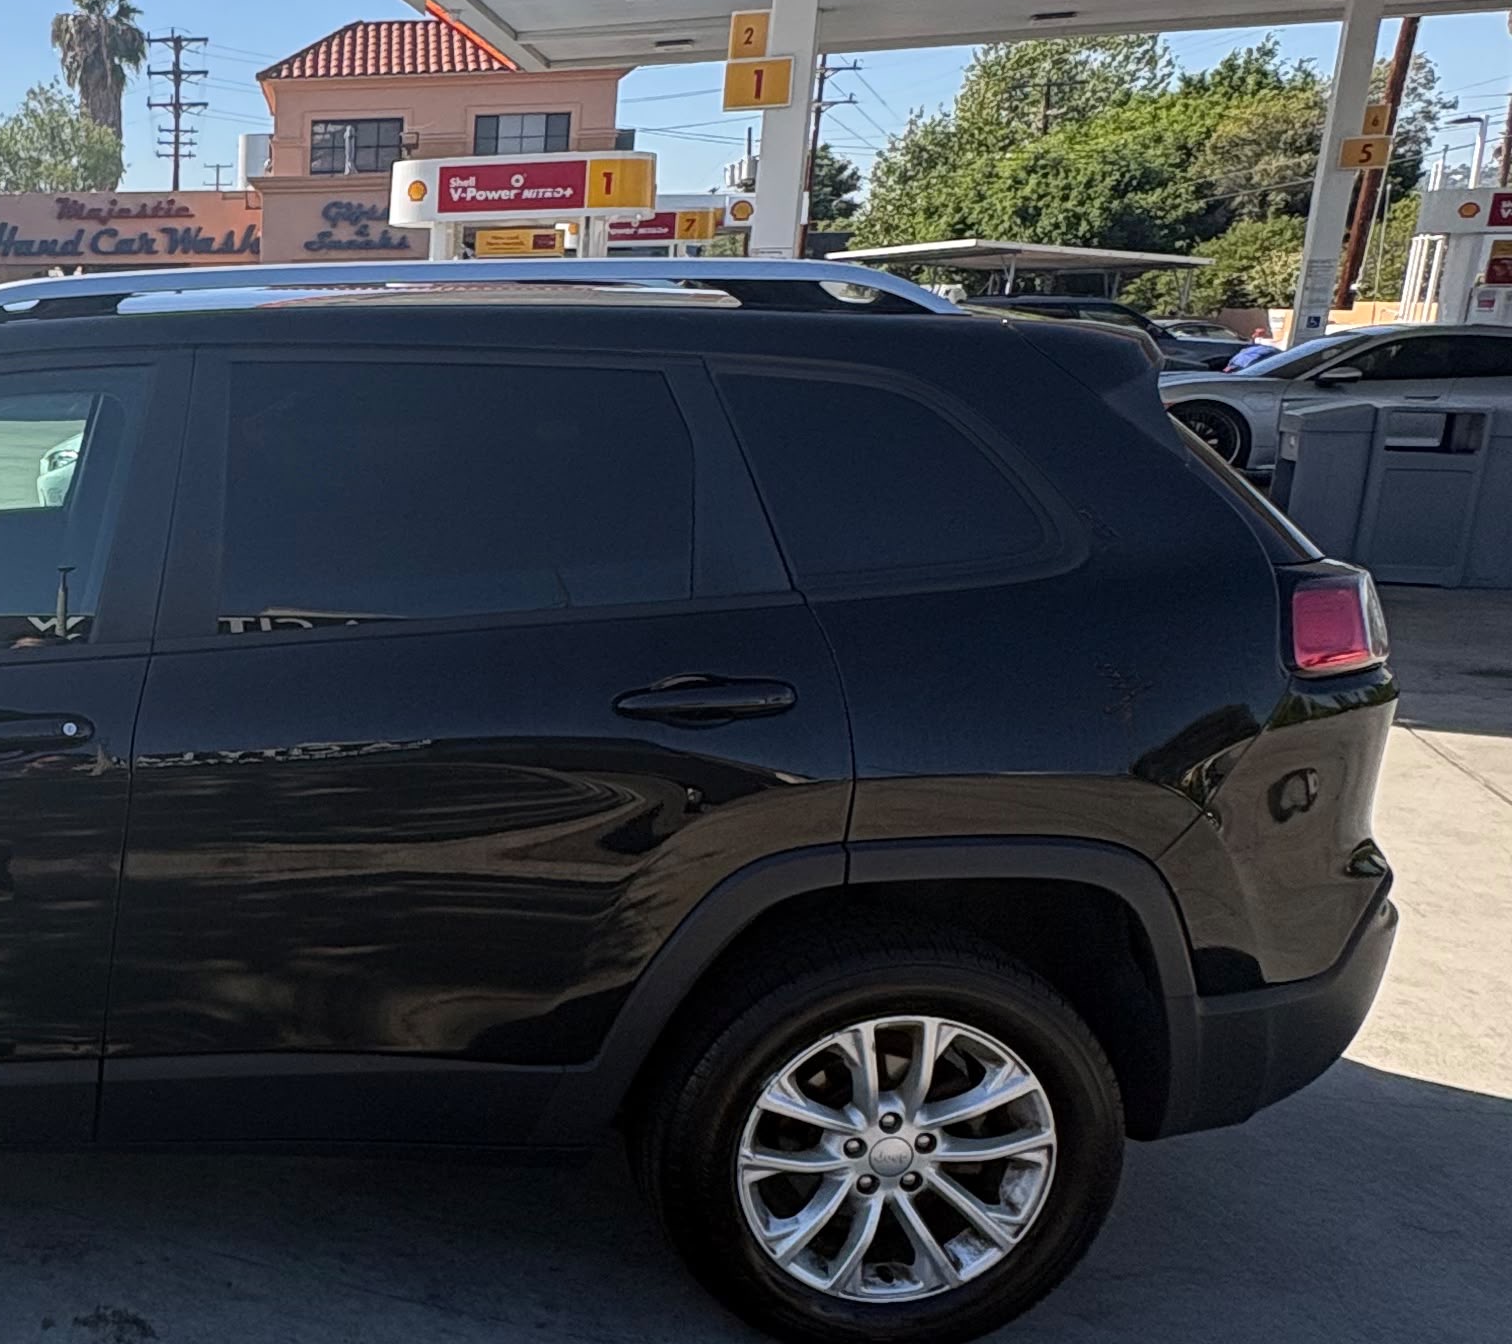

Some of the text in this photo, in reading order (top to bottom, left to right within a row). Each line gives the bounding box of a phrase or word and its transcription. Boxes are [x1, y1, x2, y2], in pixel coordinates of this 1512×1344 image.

[743, 27, 755, 46] 2
[753, 69, 764, 100] 1
[1358, 143, 1374, 164] 5
[449, 175, 476, 188] Shell
[602, 171, 614, 196] 1
[449, 187, 521, 202] V-Power
[55, 197, 196, 226] Majestic
[684, 218, 697, 233] 7
[90, 227, 159, 255] Car
[159, 223, 261, 255] Wash
